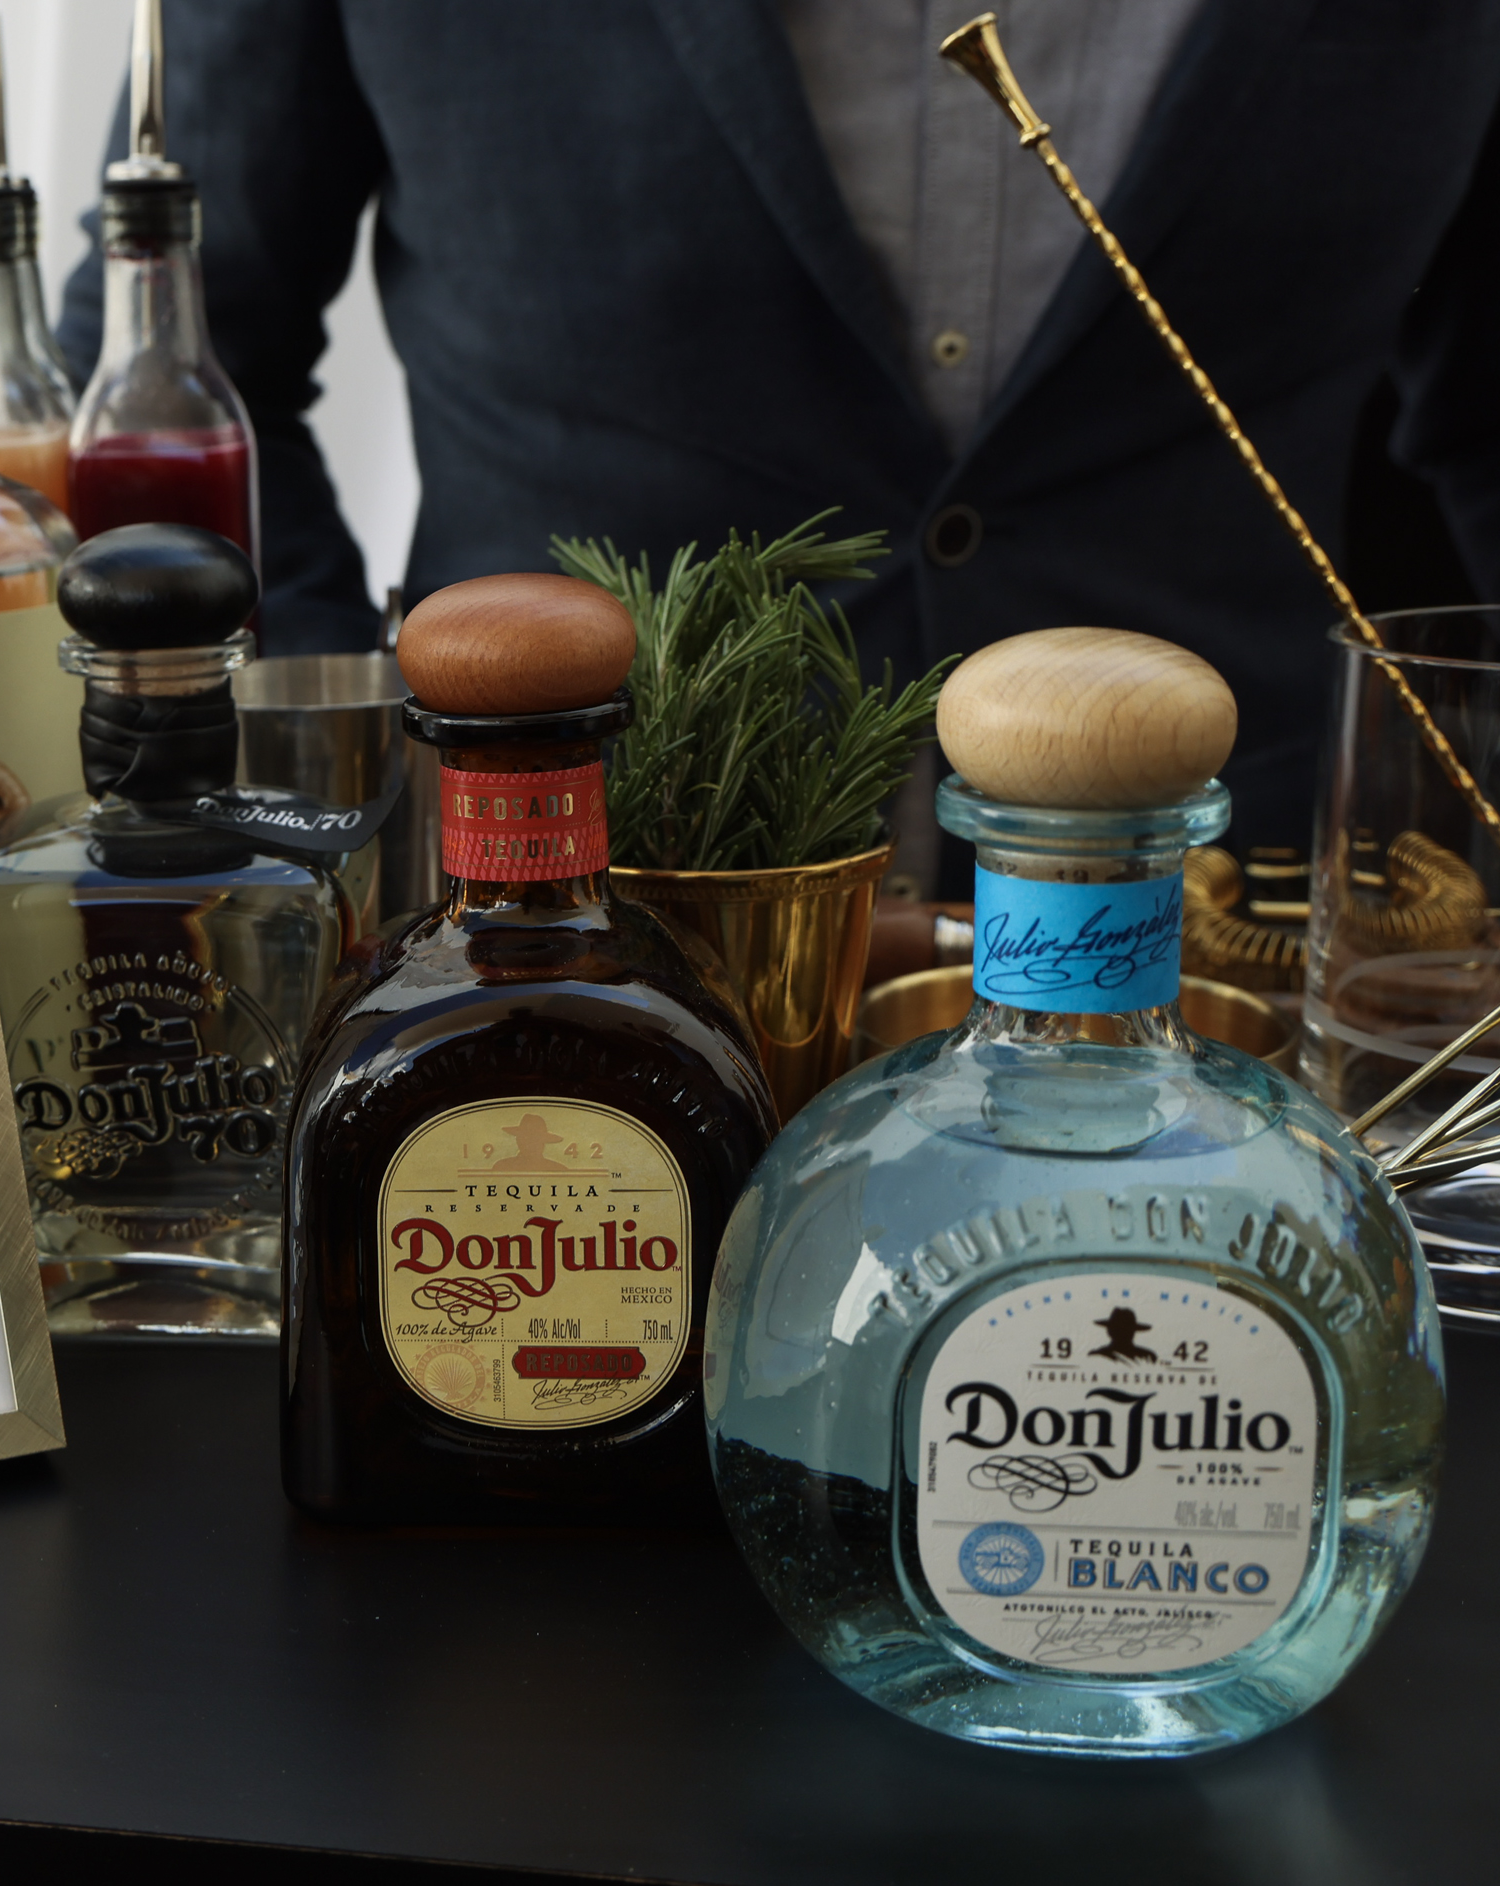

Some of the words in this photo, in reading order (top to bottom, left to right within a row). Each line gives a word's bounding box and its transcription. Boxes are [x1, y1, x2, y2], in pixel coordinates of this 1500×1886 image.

[452, 793, 574, 821] REPOSADO
[321, 810, 363, 830] 70
[481, 836, 575, 861] TEQUILA
[178, 1109, 277, 1164] 70
[465, 1185, 599, 1199] TEQUILA
[425, 1204, 583, 1212] RESERVA
[607, 1204, 640, 1212] DE
[867, 1198, 1076, 1330] TEQUILA
[1108, 1193, 1211, 1243] DON
[621, 1295, 673, 1304] MEXICO
[395, 1323, 429, 1336] 100%
[431, 1320, 448, 1335] de
[449, 1321, 498, 1343] Agave
[528, 1318, 548, 1339] 40%
[551, 1318, 581, 1340] Alc/Vol
[643, 1319, 658, 1340] 750
[660, 1320, 673, 1340] mL
[1040, 1337, 1072, 1360] 19
[1173, 1340, 1209, 1362] 42
[526, 1353, 633, 1372] REPOSADO
[493, 1359, 502, 1402] 3105463799
[1027, 1371, 1098, 1383] TEQUILA
[1111, 1373, 1187, 1385] RESERVA
[1199, 1375, 1217, 1386] DE
[1196, 1463, 1243, 1475] 100%
[1176, 1476, 1195, 1485] DE
[1208, 1477, 1261, 1487] AGAVE
[1071, 1540, 1193, 1558] TEQUILA
[1068, 1557, 1270, 1595] BLANCO
[1004, 1603, 1085, 1614] ATOTONILCO
[1091, 1606, 1107, 1615] EL
